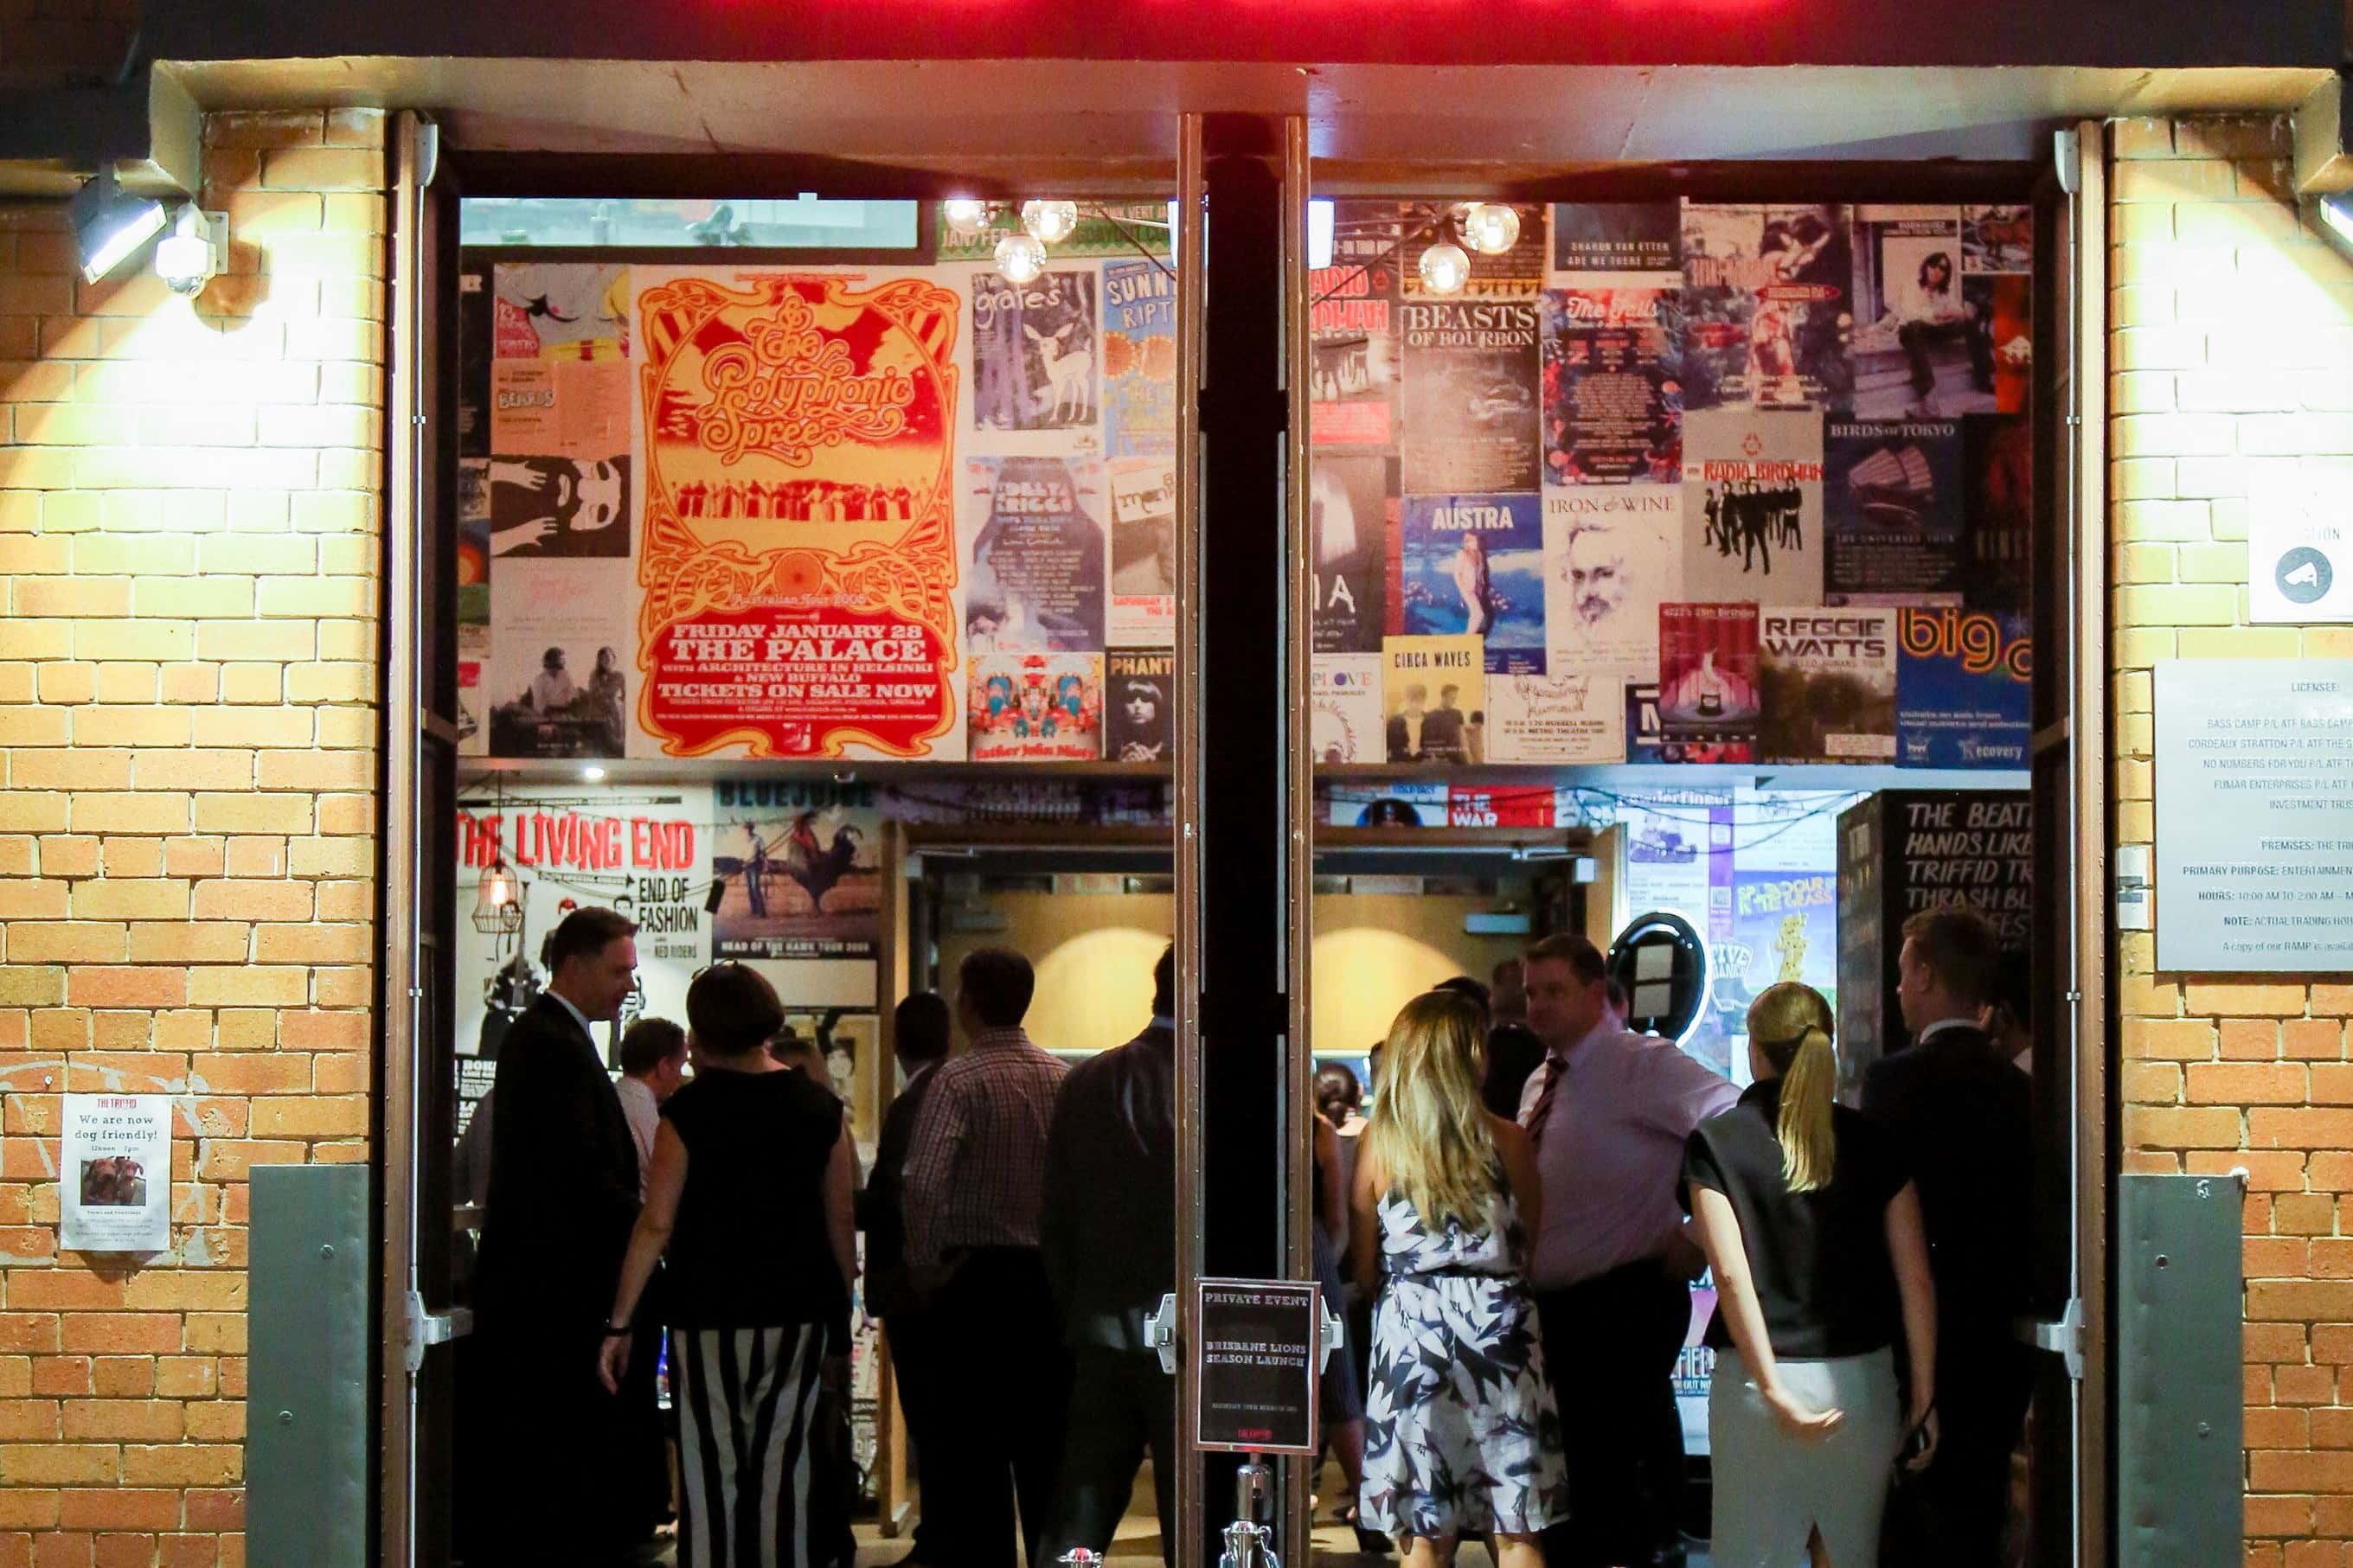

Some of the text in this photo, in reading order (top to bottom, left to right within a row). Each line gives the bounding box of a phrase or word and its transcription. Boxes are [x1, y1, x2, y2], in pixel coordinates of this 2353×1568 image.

[1571, 241, 1670, 251] SHARON VAN ETTEN
[1408, 304, 1536, 330] BEASTS
[749, 307, 824, 368] The
[1408, 331, 1535, 346] OF BOURBON
[701, 340, 915, 421] Polyphonic
[700, 400, 846, 465] Spree
[1830, 424, 1883, 437] BIRDS
[1902, 424, 1955, 437] TOKYO
[1549, 496, 1599, 514] IRON
[1621, 496, 1675, 513] WINE
[1432, 506, 1514, 530] AUSTRA
[673, 624, 922, 638] FRIDAY JANUARY 28
[1765, 618, 1885, 637] REGGIE
[1765, 639, 1886, 657] WATTS
[1901, 608, 2000, 674] big
[669, 639, 926, 661] THE PALACE
[1394, 650, 1471, 669] CIRCA WAVES
[697, 662, 828, 673] ARCHITECTURE
[830, 663, 848, 672] IN
[852, 662, 934, 673] HELSINKI
[747, 673, 785, 682] NEW
[787, 673, 862, 682] BUFFALO
[657, 684, 937, 698] TICKETS ON SALE NOW
[2208, 719, 2232, 728] BASS
[2234, 719, 2261, 728] CAMP
[2280, 720, 2297, 728] ATF
[2188, 739, 2237, 748] CORDEAUX
[2240, 739, 2287, 748] STRATTON
[2307, 739, 2324, 748] ATF
[2326, 739, 2344, 748] THE
[2203, 759, 2217, 769] NO
[2220, 759, 2266, 769] NUMBERS
[2268, 759, 2287, 769] FOR
[2288, 759, 2306, 769] YOU
[2326, 759, 2343, 769] ATF
[2214, 780, 2247, 790] FUMAR
[2249, 780, 2311, 790] ENTERPRISES
[2332, 780, 2348, 790] ATF
[2269, 800, 2328, 810] INVESTMENT
[1452, 812, 1498, 827] WAR
[1907, 803, 1956, 828] THE
[516, 810, 622, 870] LIVING
[632, 816, 695, 870] END
[1906, 832, 1983, 855] HANDS
[2261, 841, 2314, 850] PREMISES:
[2318, 841, 2334, 850] THE
[1906, 861, 1998, 883] TRIFFID
[2183, 867, 2227, 875] PRIMARY
[2230, 867, 2279, 875] PURPOSE:
[638, 877, 689, 903] END OF
[2198, 892, 2334, 900] HOURS: 10:00 AM TO 2:00 AM
[1905, 888, 1998, 909] THRASH
[638, 906, 698, 933] FASHION
[2224, 917, 2253, 926] NOTE:
[2254, 917, 2288, 926] ACTUAL
[2292, 917, 2331, 926] TRADING
[2223, 942, 2229, 950] A
[2285, 942, 2311, 950] RAMP
[80, 1115, 98, 1124] We
[75, 1130, 157, 1142] dog friendly!
[1205, 1293, 1309, 1307] PRIVATE EVENT
[1206, 1341, 1306, 1354] BRISBANE LIONS
[1206, 1354, 1305, 1367] SEASON LAUNCH
